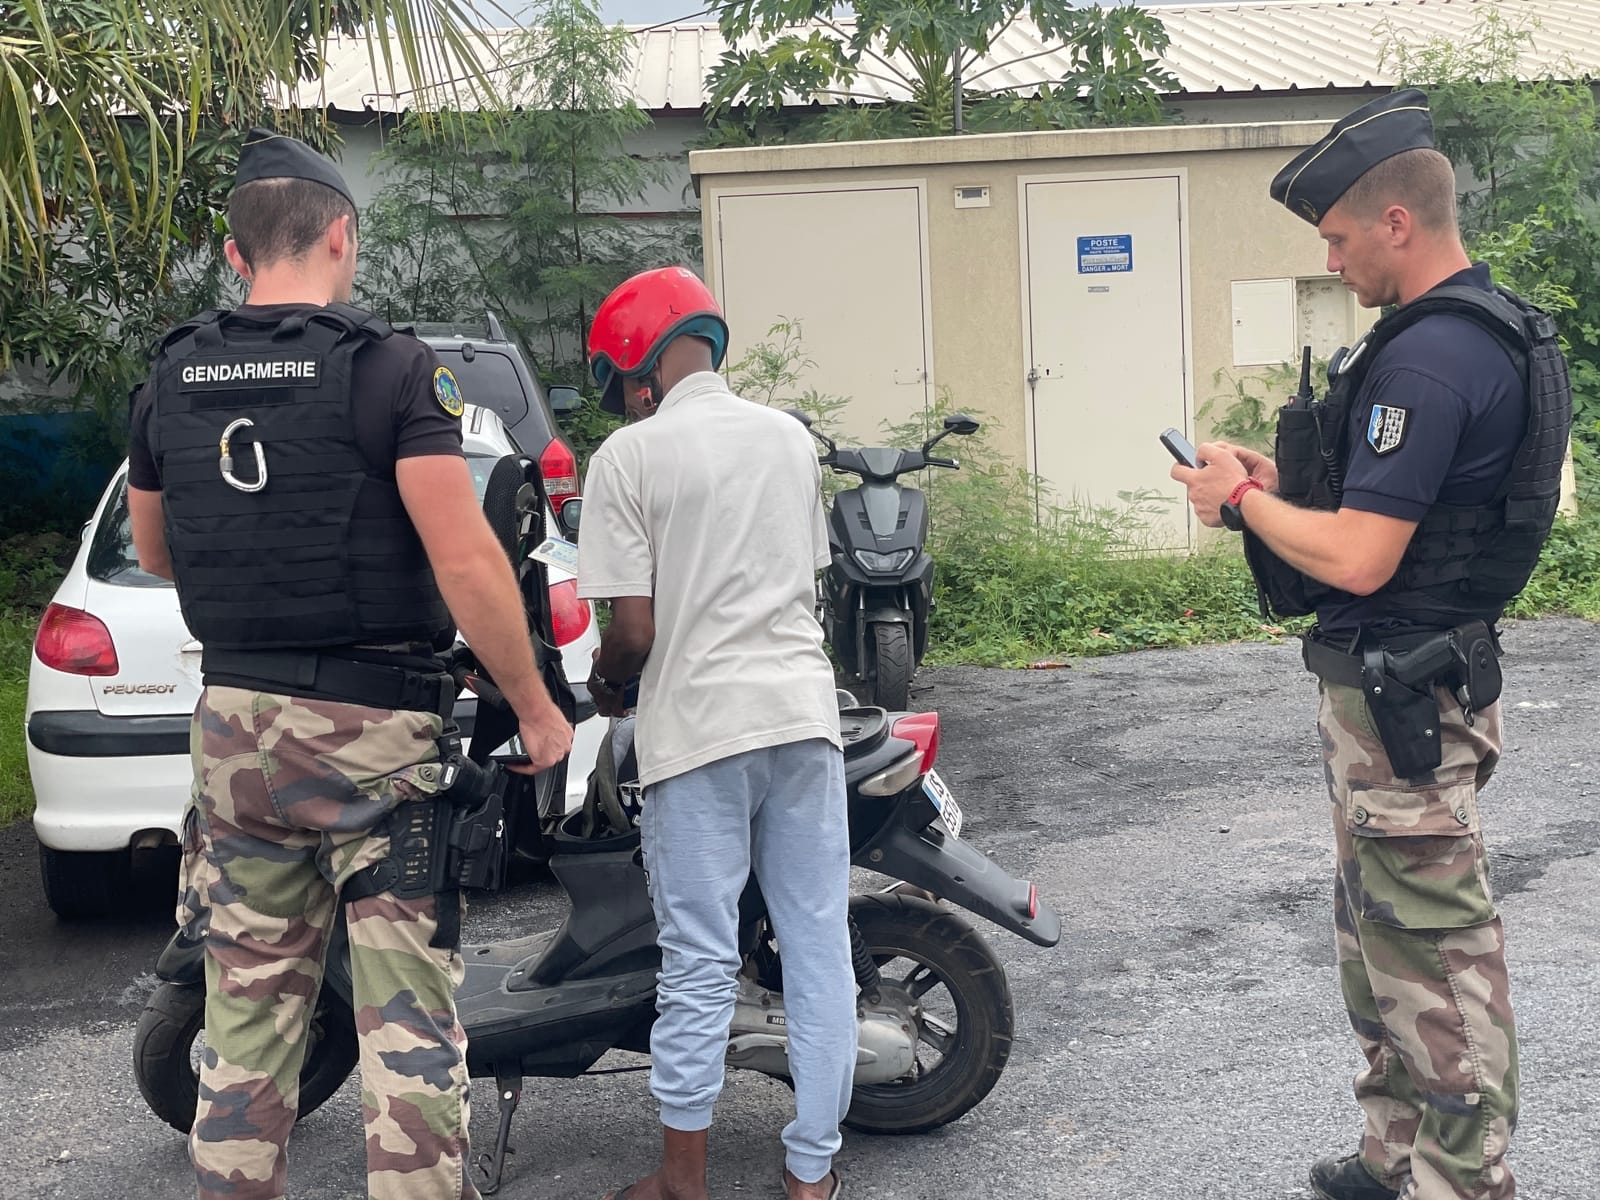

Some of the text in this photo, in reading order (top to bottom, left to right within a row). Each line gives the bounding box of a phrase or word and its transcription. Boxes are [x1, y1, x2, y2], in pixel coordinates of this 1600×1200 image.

[1091, 239, 1118, 247] POSTE
[182, 361, 316, 383] GENDARMERIE
[103, 684, 177, 695] PEUGEOT
